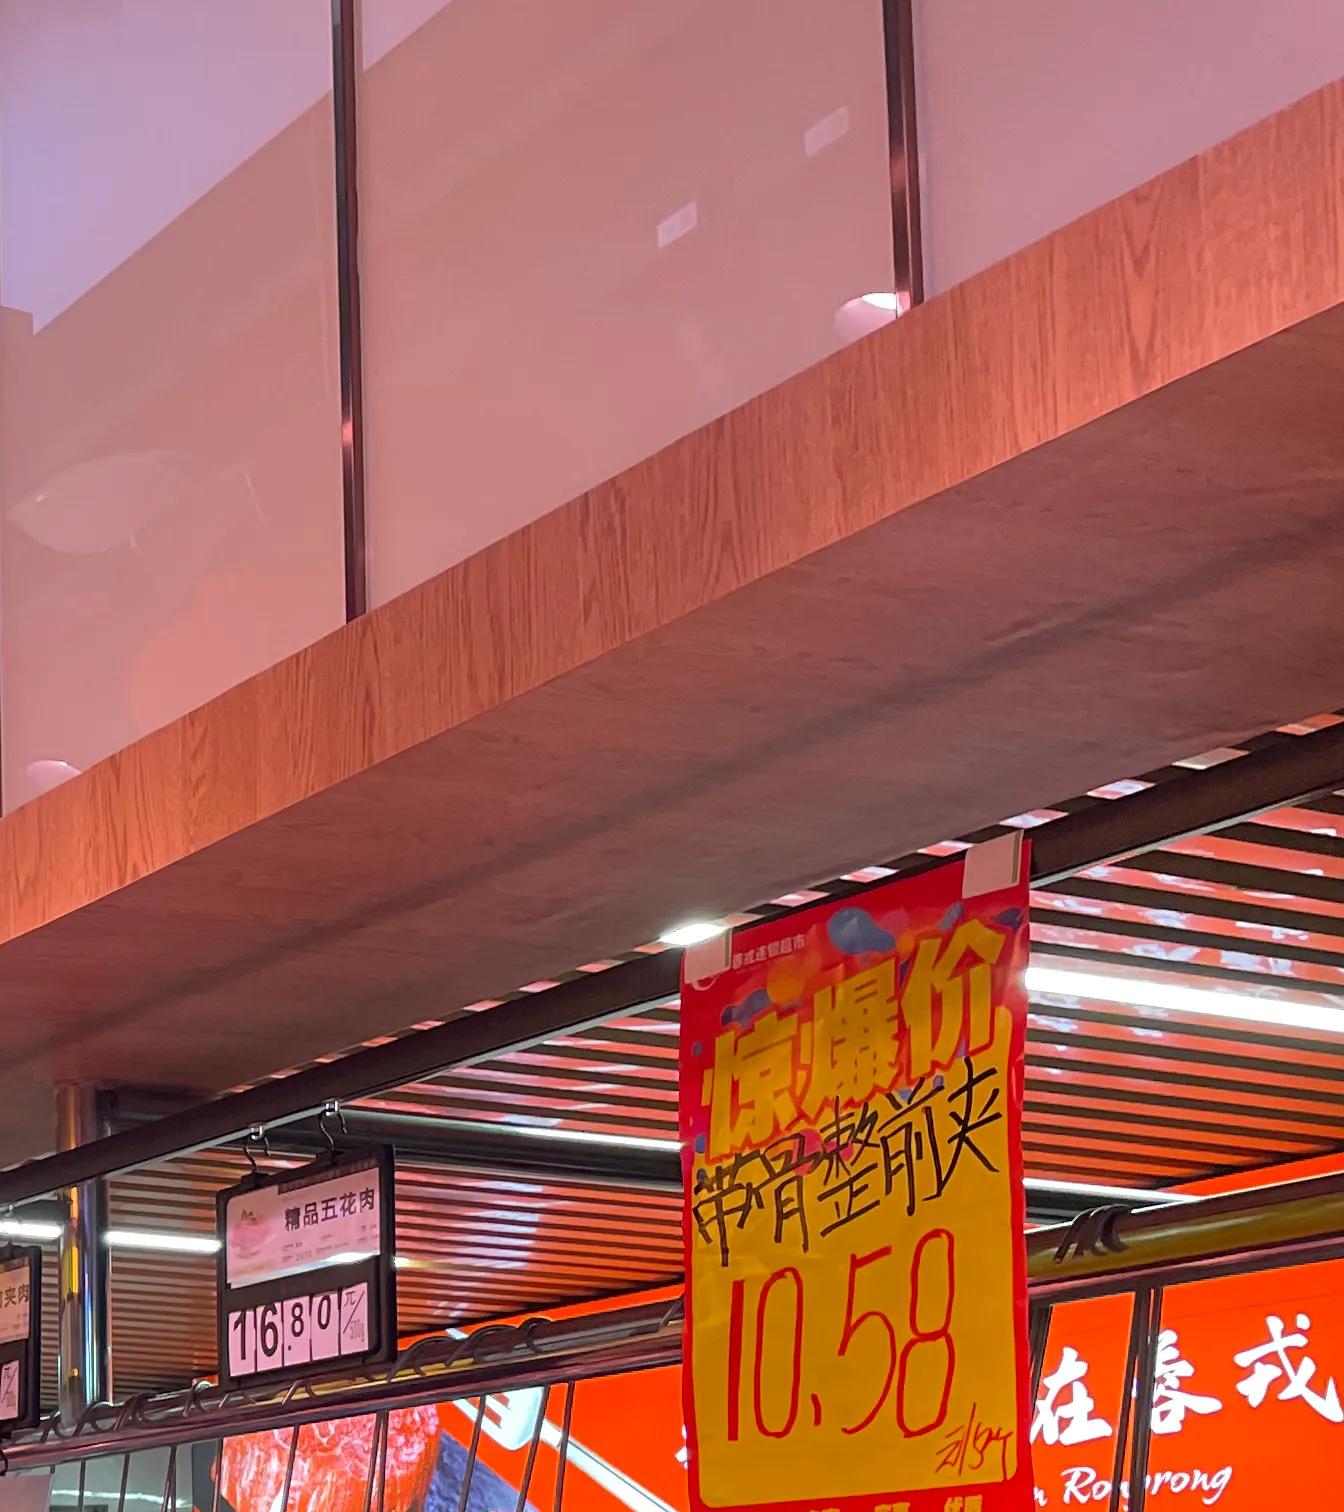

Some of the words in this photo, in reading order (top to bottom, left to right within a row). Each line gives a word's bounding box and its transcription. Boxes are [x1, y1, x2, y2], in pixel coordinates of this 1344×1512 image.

[700, 917, 1007, 1166] 惊爆价
[283, 1186, 376, 1232] 精品五花肉
[693, 1056, 1004, 1267] 带骨整前夹
[232, 1294, 332, 1361] 16.80
[726, 1227, 957, 1442] 10.58
